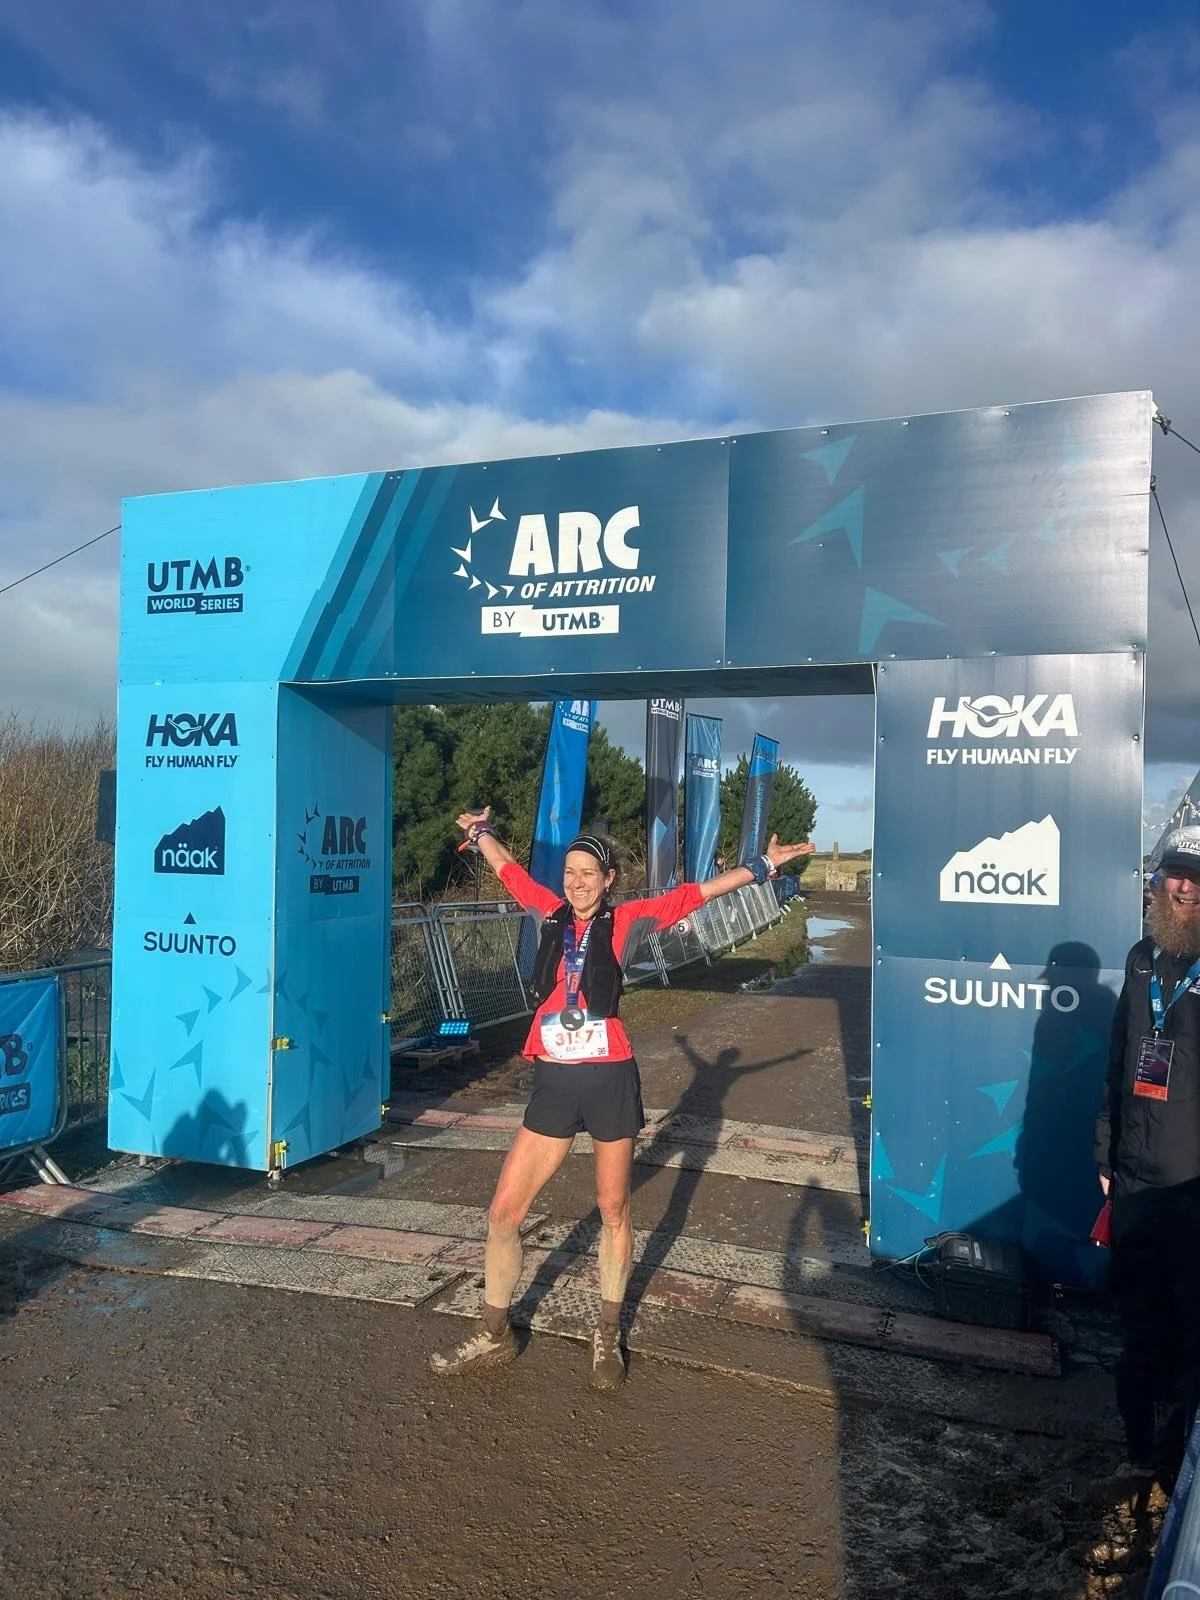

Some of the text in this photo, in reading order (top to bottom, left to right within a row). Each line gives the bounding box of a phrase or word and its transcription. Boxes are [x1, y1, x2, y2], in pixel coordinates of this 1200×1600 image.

[508, 505, 641, 576] ARC
[520, 575, 656, 599] OF ATTRITION
[151, 598, 240, 611] WORLD SERIES
[493, 611, 516, 628] BY
[926, 693, 1079, 739] HOKA
[145, 712, 239, 747] HOKA
[145, 755, 238, 768] FLY HUMAN FLY
[697, 757, 718, 769] ARC
[926, 747, 1079, 765] FLY HUMAN FLY
[321, 815, 367, 855] ARC
[1179, 841, 1200, 850] UTM
[162, 842, 218, 869] näak
[325, 858, 371, 870] OF ATTRITION
[313, 878, 354, 892] BY UTMB
[955, 862, 1048, 896] näak
[144, 931, 237, 957] SUUNTO
[924, 977, 1080, 1013] SUUNTO
